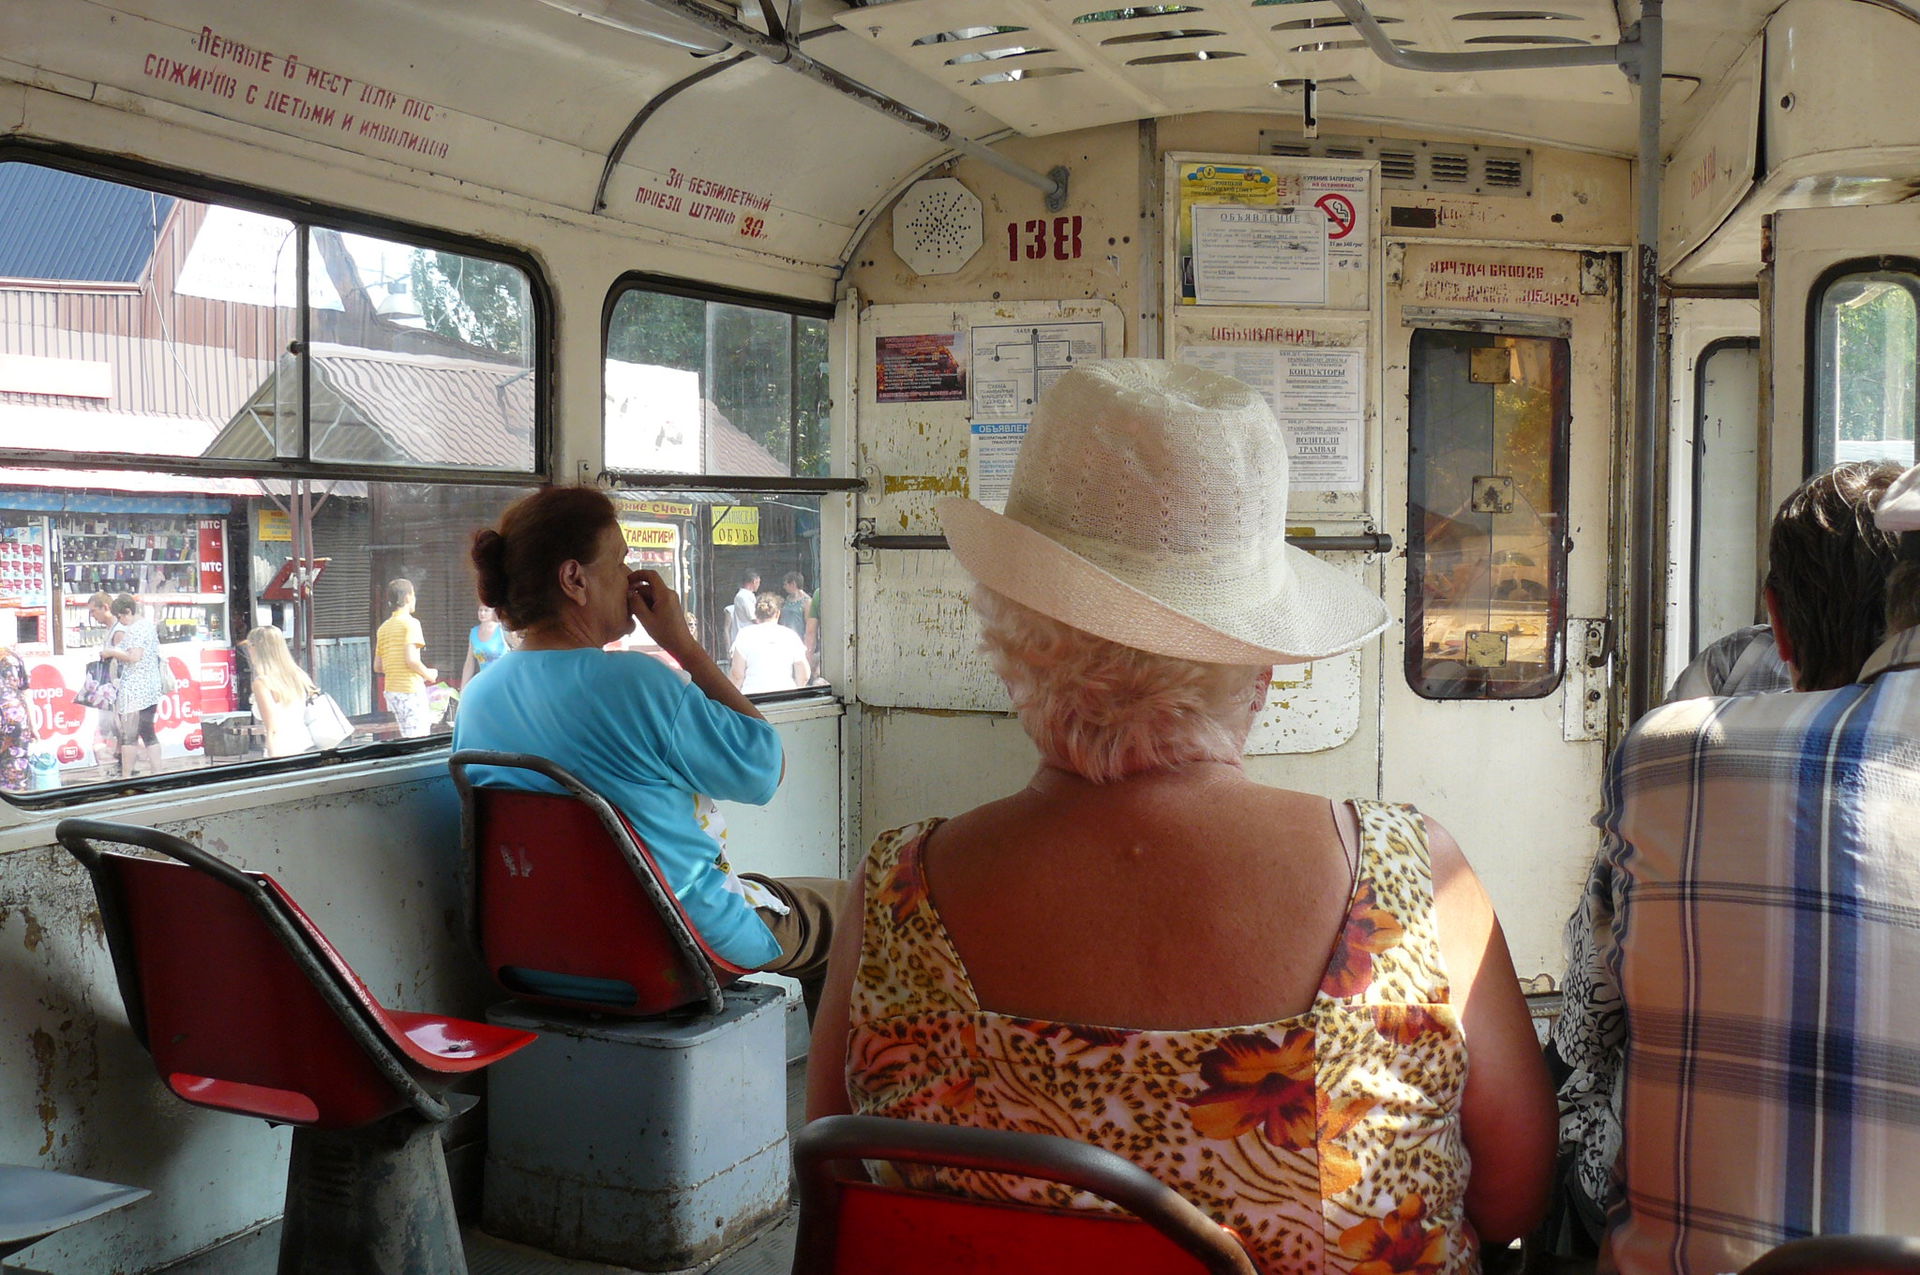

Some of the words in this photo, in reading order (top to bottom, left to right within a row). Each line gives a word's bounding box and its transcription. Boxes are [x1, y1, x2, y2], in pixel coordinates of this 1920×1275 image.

[198, 26, 273, 73] ПЕРВЫЕ
[306, 68, 352, 96] МЕСТ
[246, 84, 256, 105] С
[265, 90, 335, 126] ДЕТЬМИ
[341, 112, 352, 131] И
[1220, 213, 1300, 223] ОБЪЯВЛЕНИЕ
[1289, 368, 1345, 377] КОНДУКТОРЫ
[979, 424, 1029, 433] ОБЪЯВЛЕН
[1298, 446, 1337, 454] ТРАМВАЯ
[652, 503, 690, 514] счета
[200, 520, 220, 529] МТС
[719, 528, 755, 543] ОБУВЬ
[201, 562, 222, 572] МТС
